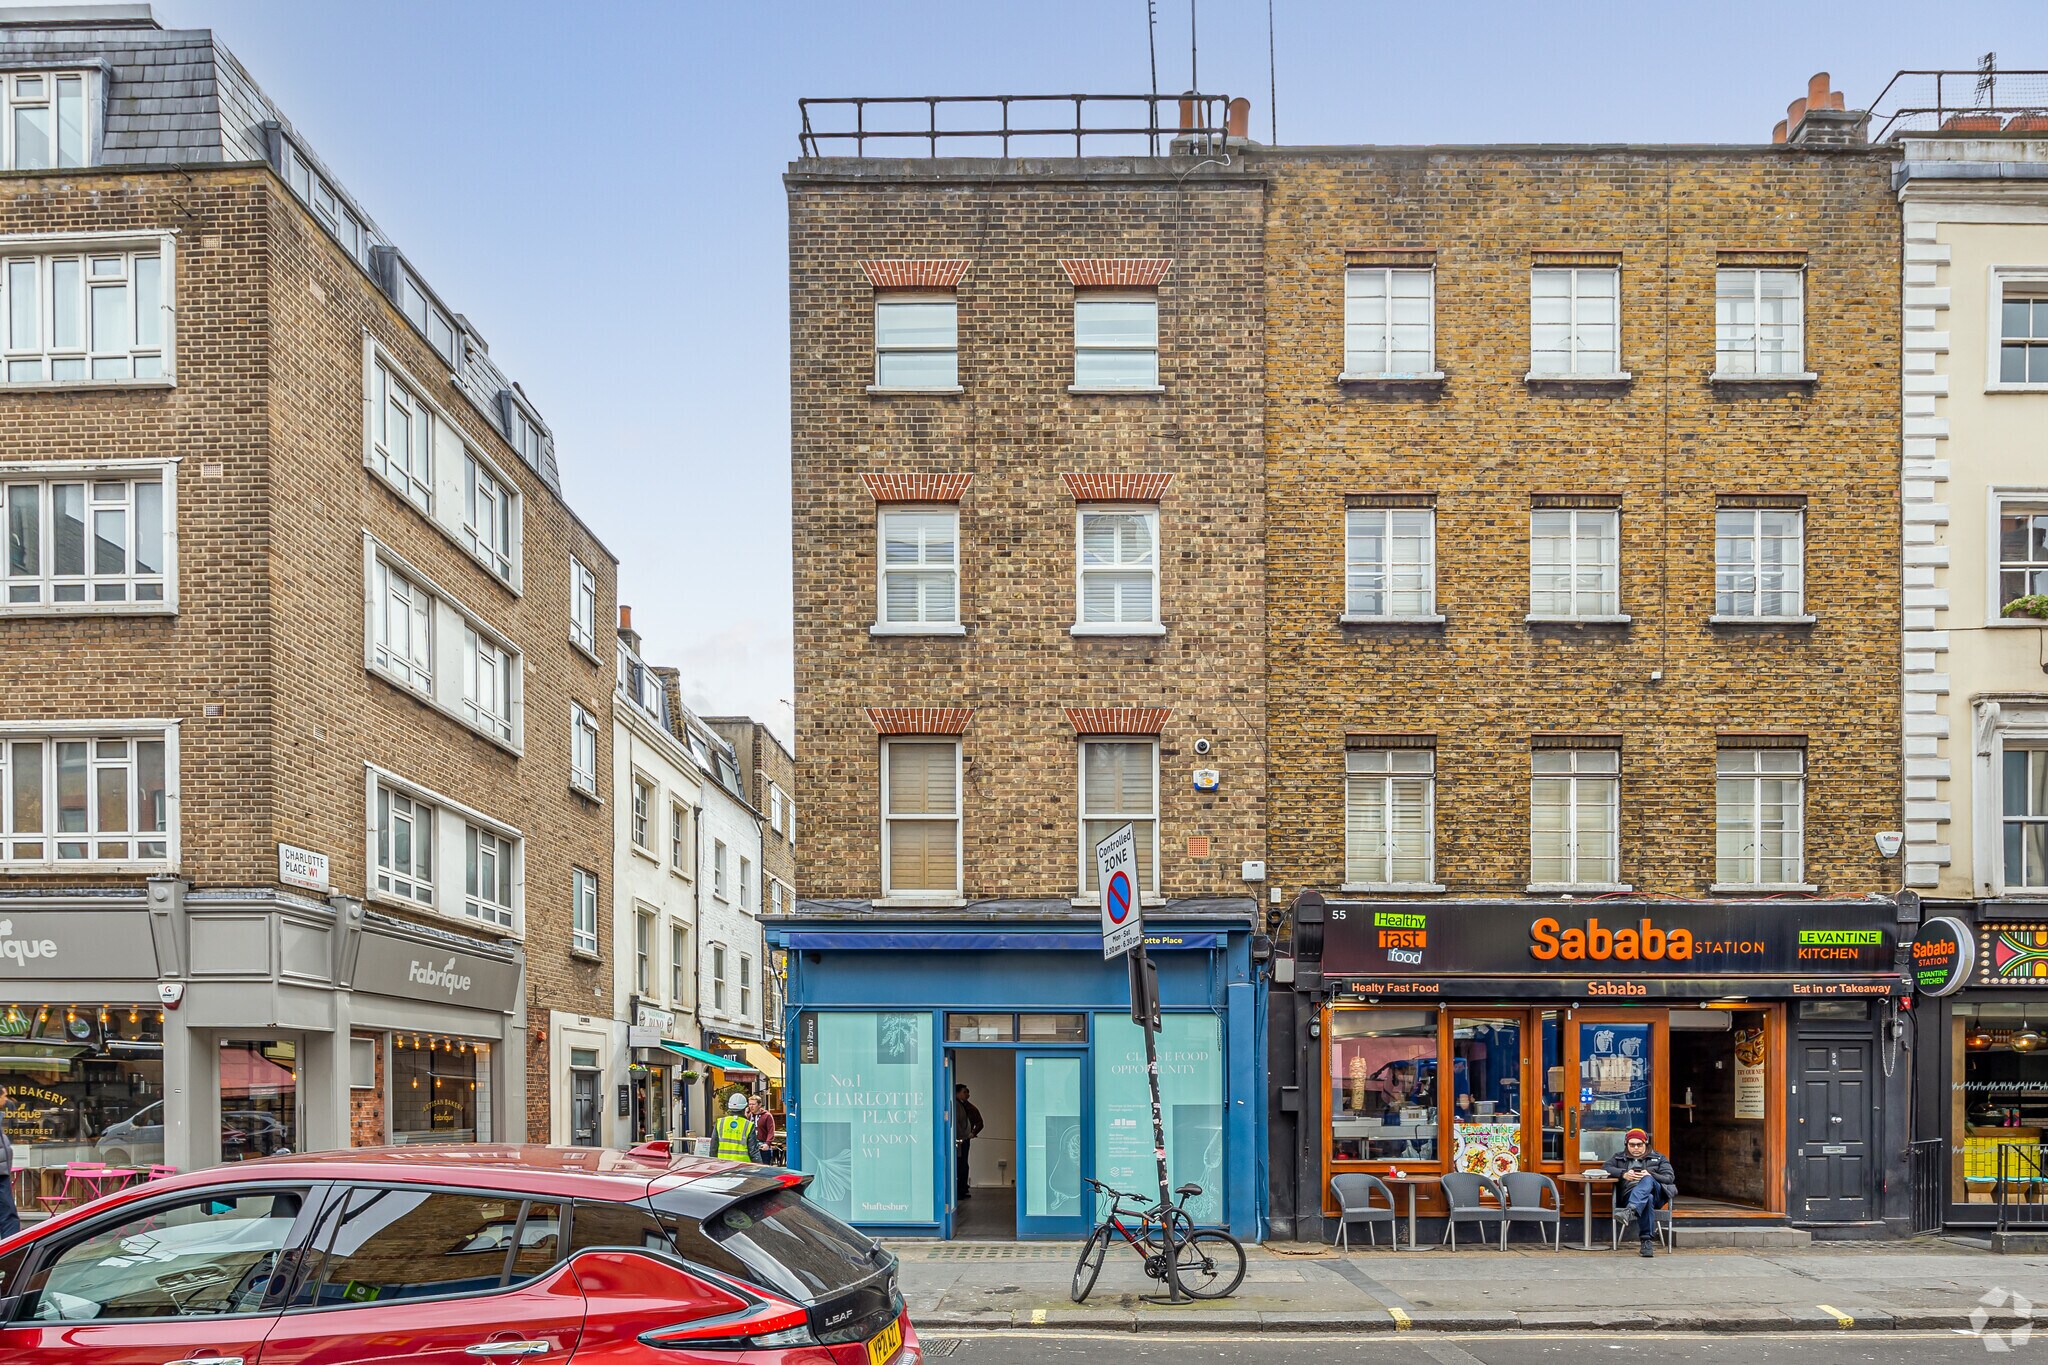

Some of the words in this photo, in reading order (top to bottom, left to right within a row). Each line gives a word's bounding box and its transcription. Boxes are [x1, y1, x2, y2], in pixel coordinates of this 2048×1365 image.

[1099, 830, 1131, 858] Controlled
[286, 849, 324, 868] CHARLOTTE
[1105, 848, 1128, 873] ZONE
[286, 861, 306, 876] PLACE
[308, 867, 318, 878] W1
[1332, 910, 1346, 920] 55
[1378, 914, 1426, 928] Healthy
[1112, 934, 1120, 943] Mon
[1384, 930, 1420, 948] fast
[1530, 917, 1692, 960] Sababa
[1695, 941, 1765, 954] STATION
[1800, 932, 1877, 943] LEVANTINE
[1798, 948, 1858, 959] KITCHEN
[1913, 939, 1956, 958] Sababa
[1391, 948, 1422, 964] food
[1918, 957, 1948, 967] STATION
[409, 958, 471, 995] Fabrique
[1917, 970, 1948, 978] LEVANTINE
[1352, 983, 1384, 994] Healty
[1387, 983, 1410, 992] Fast
[1412, 983, 1439, 993] Food
[1588, 982, 1646, 995] Sababa
[1793, 984, 1810, 993] Eat
[1813, 984, 1822, 993] in
[1839, 984, 1891, 994] Takeaway
[1126, 1052, 1161, 1061] CLS
[1166, 1052, 1171, 1061] E
[1176, 1052, 1208, 1061] FOOD
[1112, 1065, 1196, 1074] OPPOUNITY
[20, 1086, 67, 1105] BAKERY
[814, 1092, 924, 1106] CHARLOTTE
[445, 1099, 464, 1111] BAKERY
[4, 1107, 41, 1121] brique
[863, 1110, 918, 1124] PLACE
[862, 1134, 918, 1144] LONDON
[862, 1148, 880, 1158] W1
[862, 1203, 909, 1212] Shaftesbury
[825, 1310, 853, 1326] LEAF
